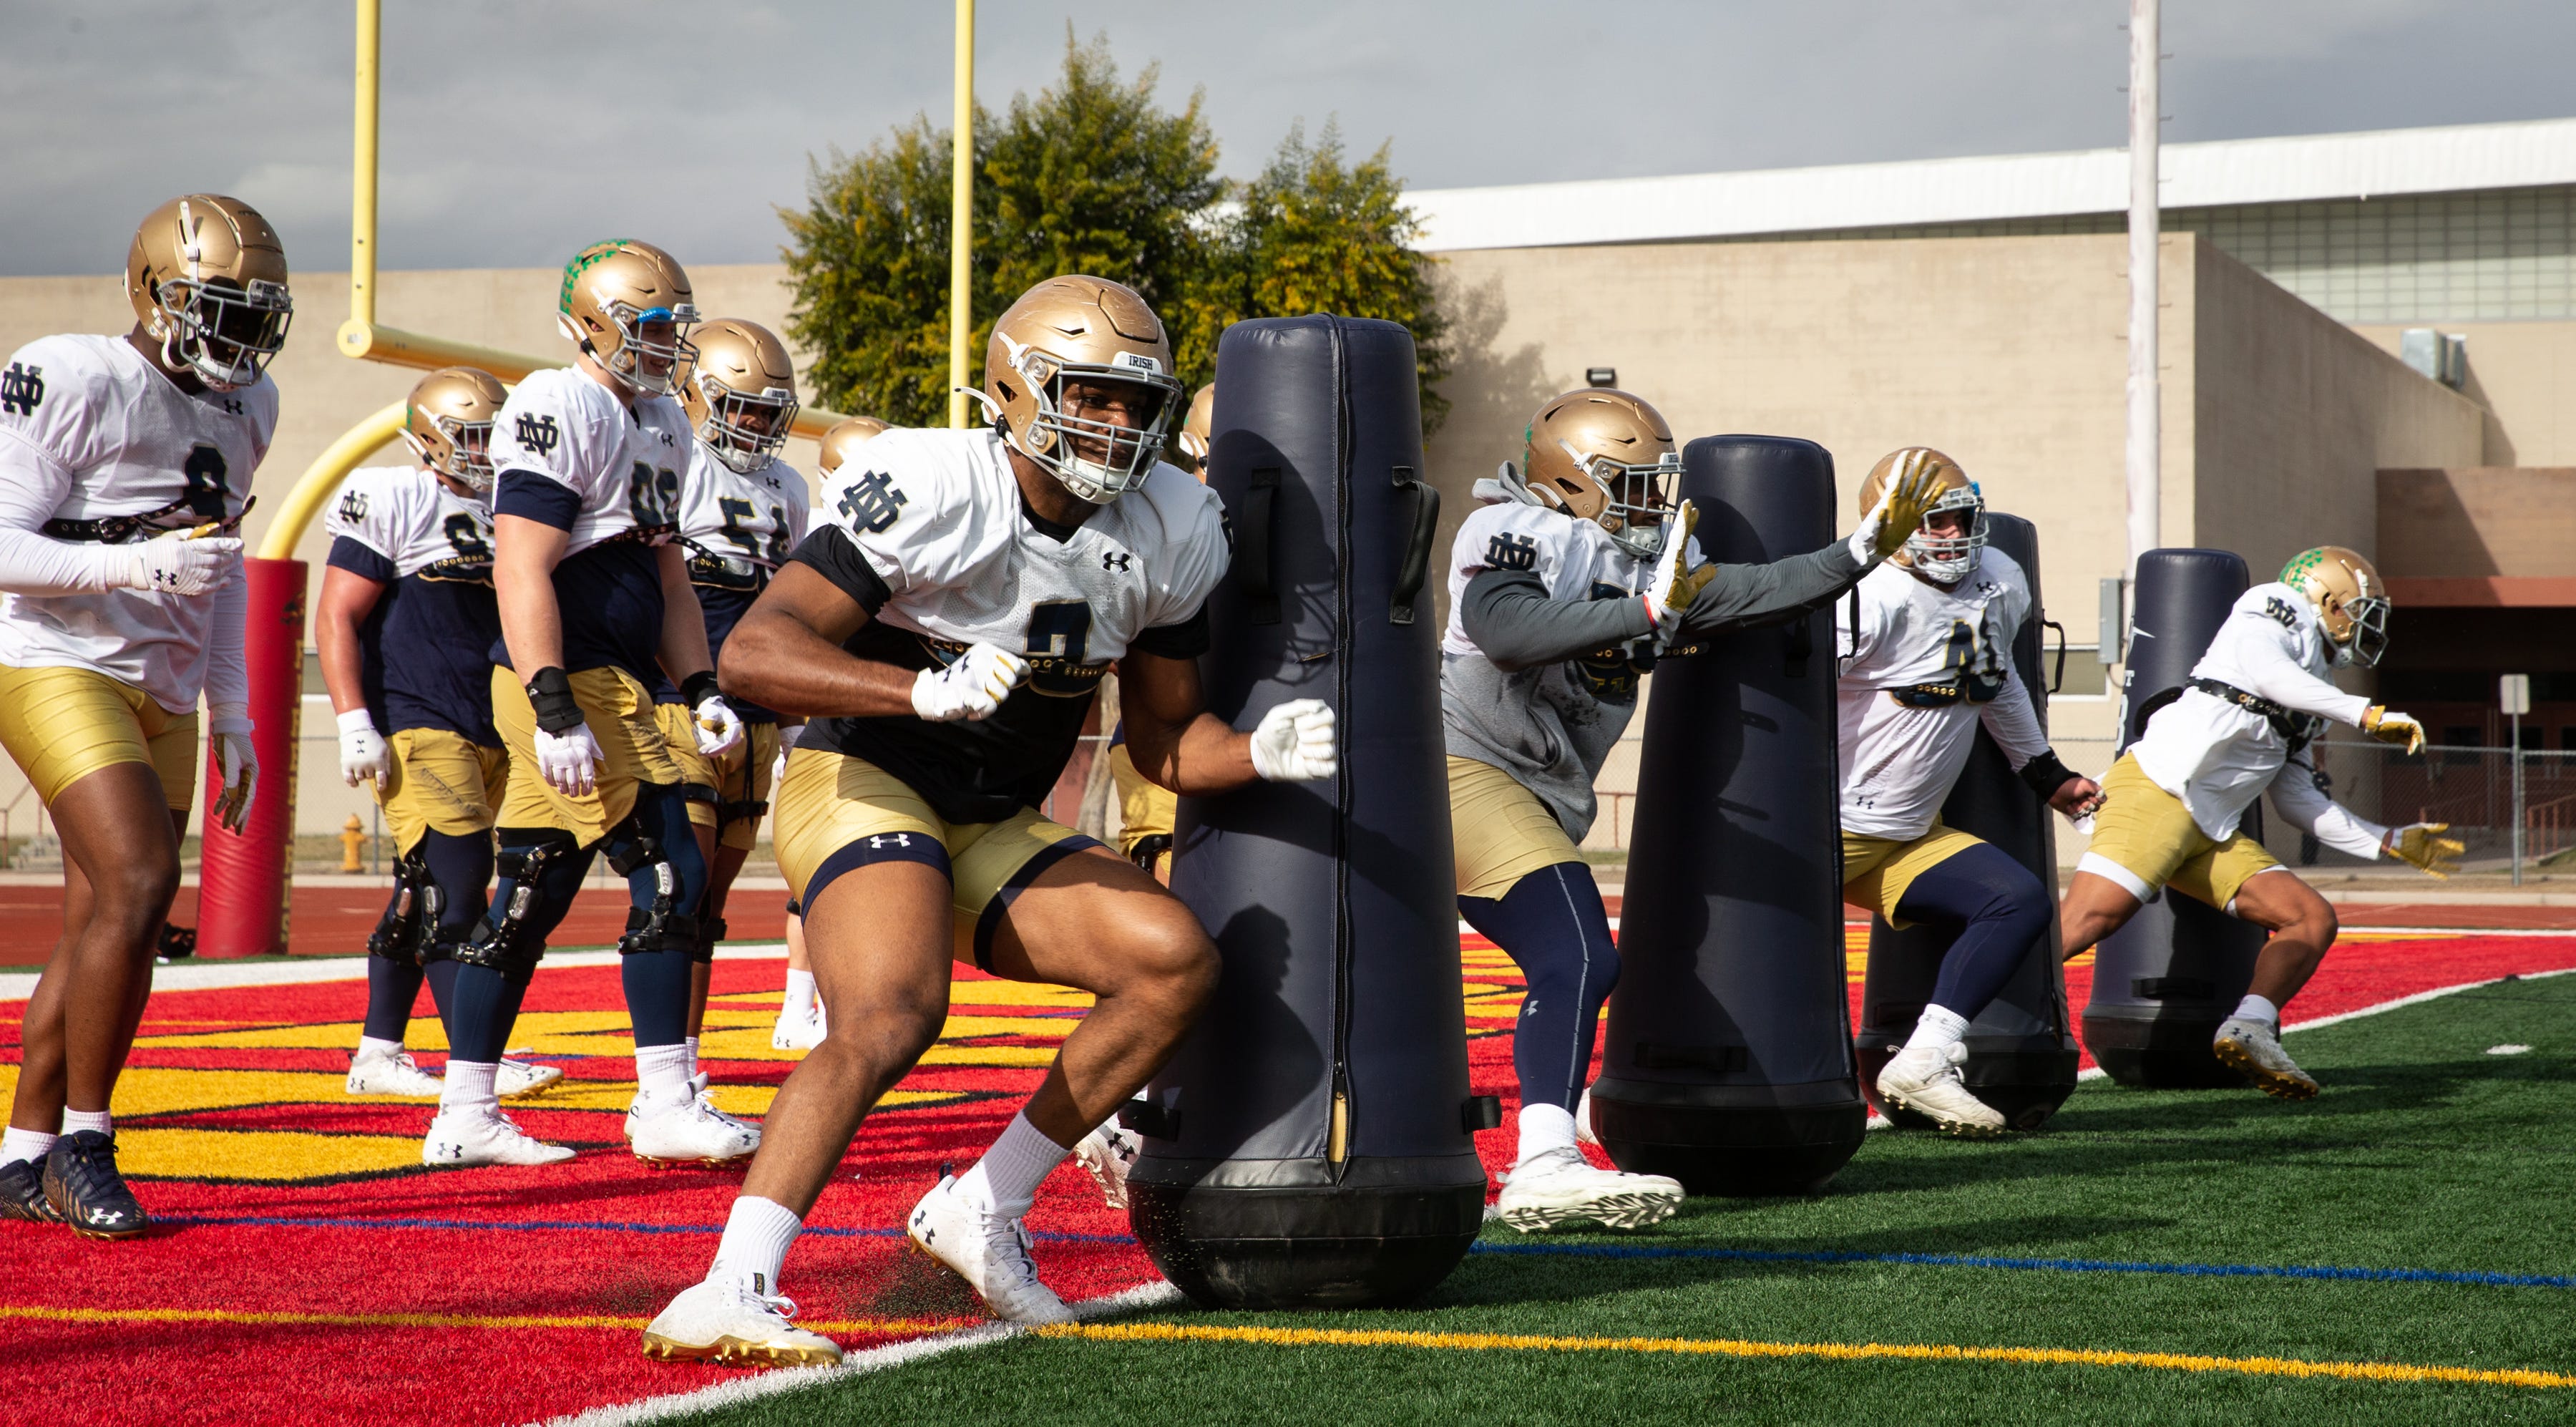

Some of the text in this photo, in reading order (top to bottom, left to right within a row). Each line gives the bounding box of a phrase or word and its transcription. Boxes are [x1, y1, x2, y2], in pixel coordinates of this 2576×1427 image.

[1128, 354, 1153, 371] IRISH
[517, 412, 558, 457] ND
[837, 470, 909, 535] ND
[1484, 532, 1537, 570] ND
